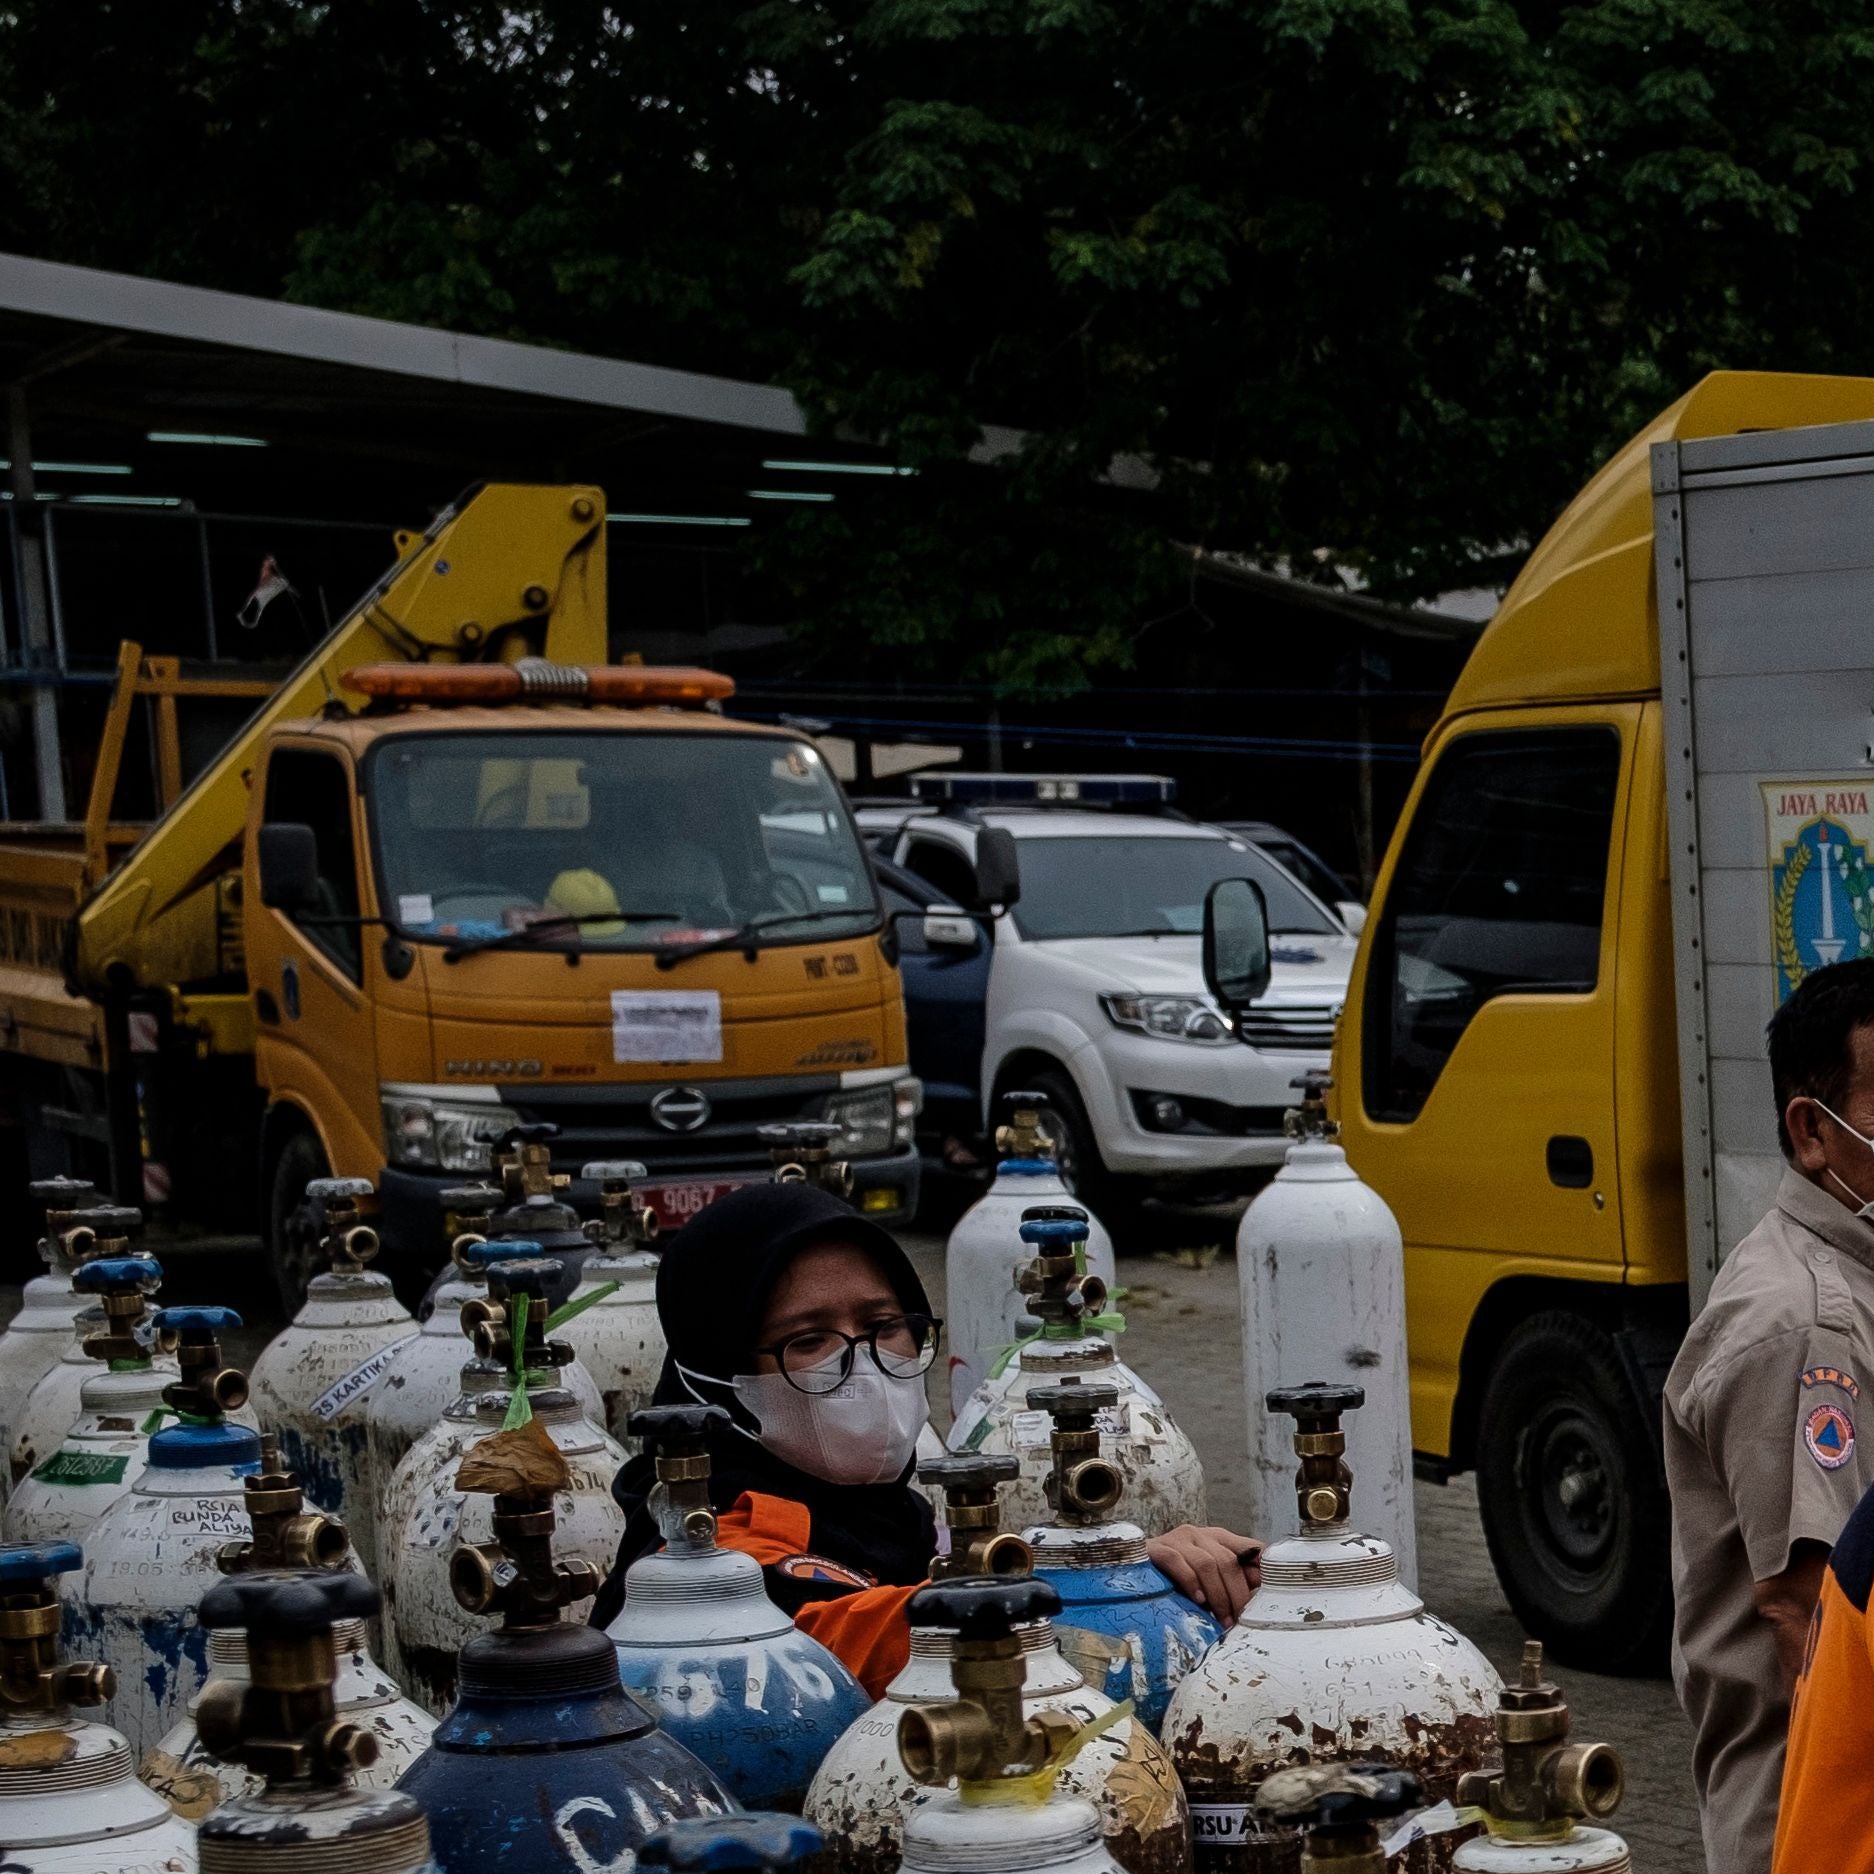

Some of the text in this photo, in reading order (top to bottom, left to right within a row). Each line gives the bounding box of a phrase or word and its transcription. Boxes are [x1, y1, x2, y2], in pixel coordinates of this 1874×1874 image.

[1777, 790, 1869, 817] JAYA RAYA
[1193, 1815, 1232, 1836] RSU
